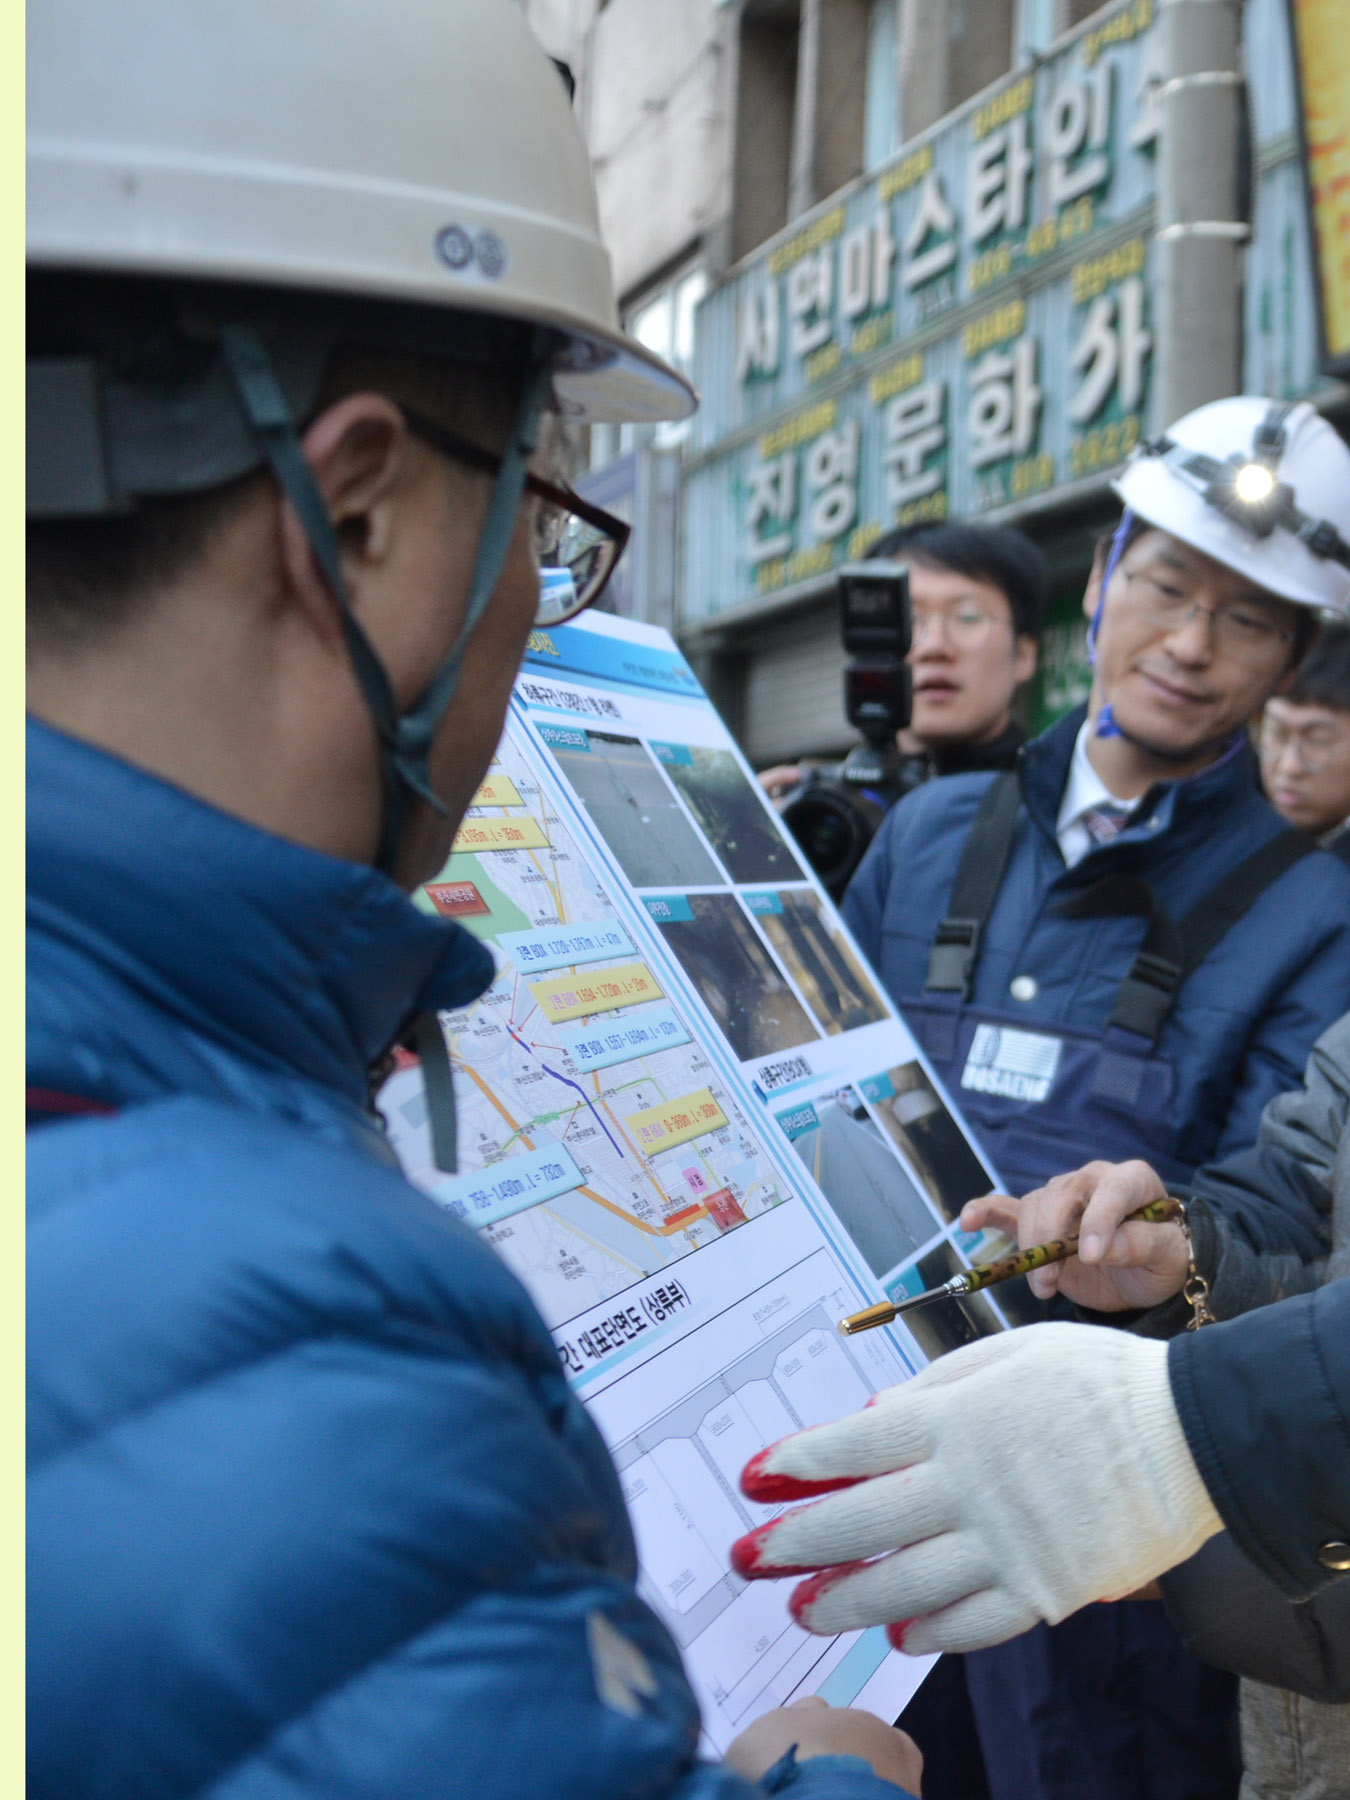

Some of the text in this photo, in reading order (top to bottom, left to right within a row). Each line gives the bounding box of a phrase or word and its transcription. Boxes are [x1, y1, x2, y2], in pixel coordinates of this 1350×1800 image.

[745, 278, 1153, 562] 진영문화사
[577, 1306, 647, 1358] 대표단면도
[639, 1278, 692, 1326] (상류부)
